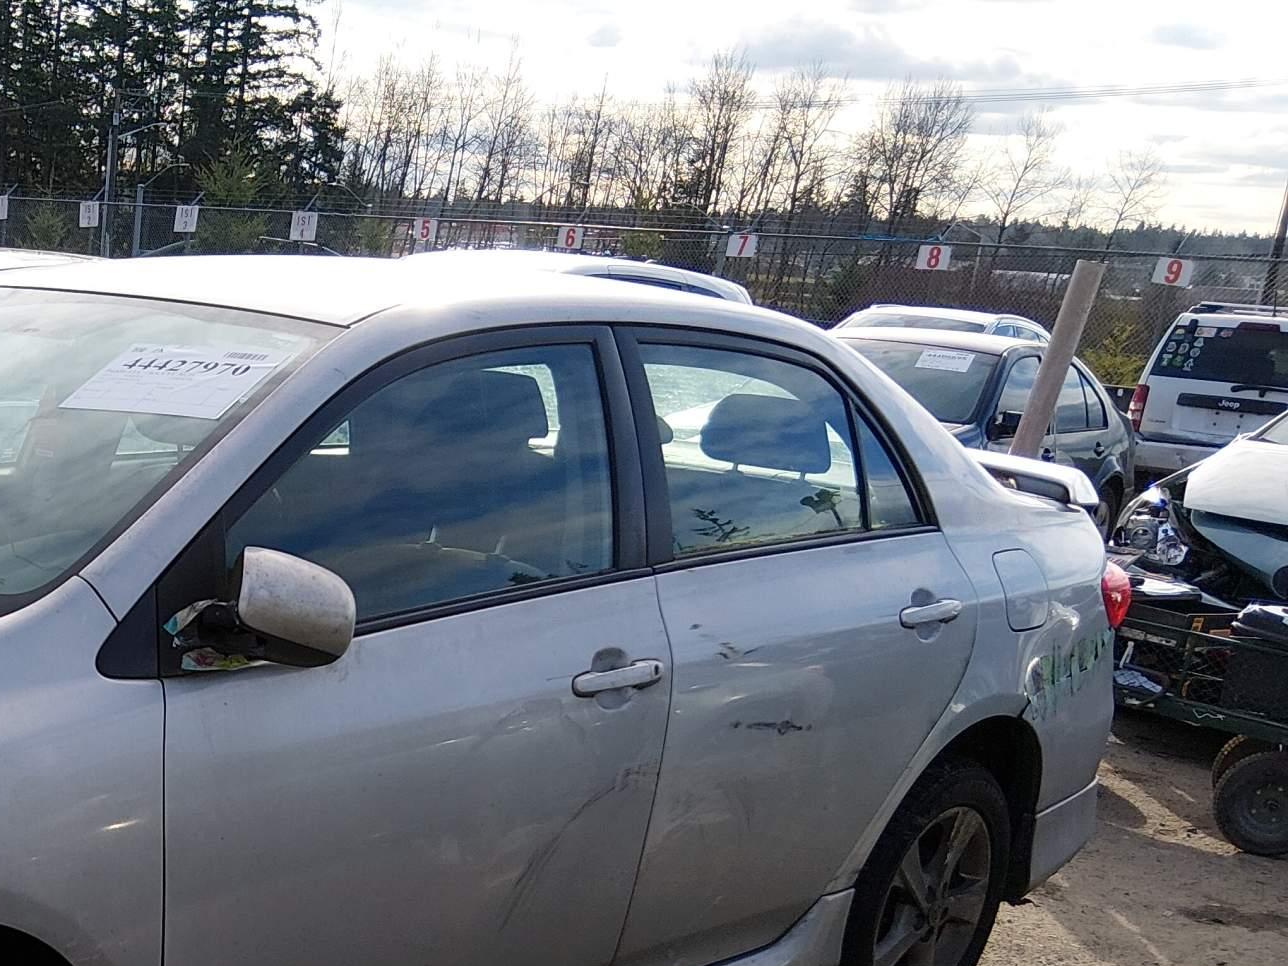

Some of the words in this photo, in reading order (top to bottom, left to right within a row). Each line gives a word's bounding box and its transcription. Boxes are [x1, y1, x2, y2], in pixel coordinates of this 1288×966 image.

[420, 219, 431, 239] 5
[565, 228, 576, 247] 6
[737, 236, 749, 256] 7
[926, 246, 942, 268] 8
[1164, 259, 1183, 284] 9
[122, 357, 252, 376] 44427970
[1218, 400, 1241, 410] Jeep
